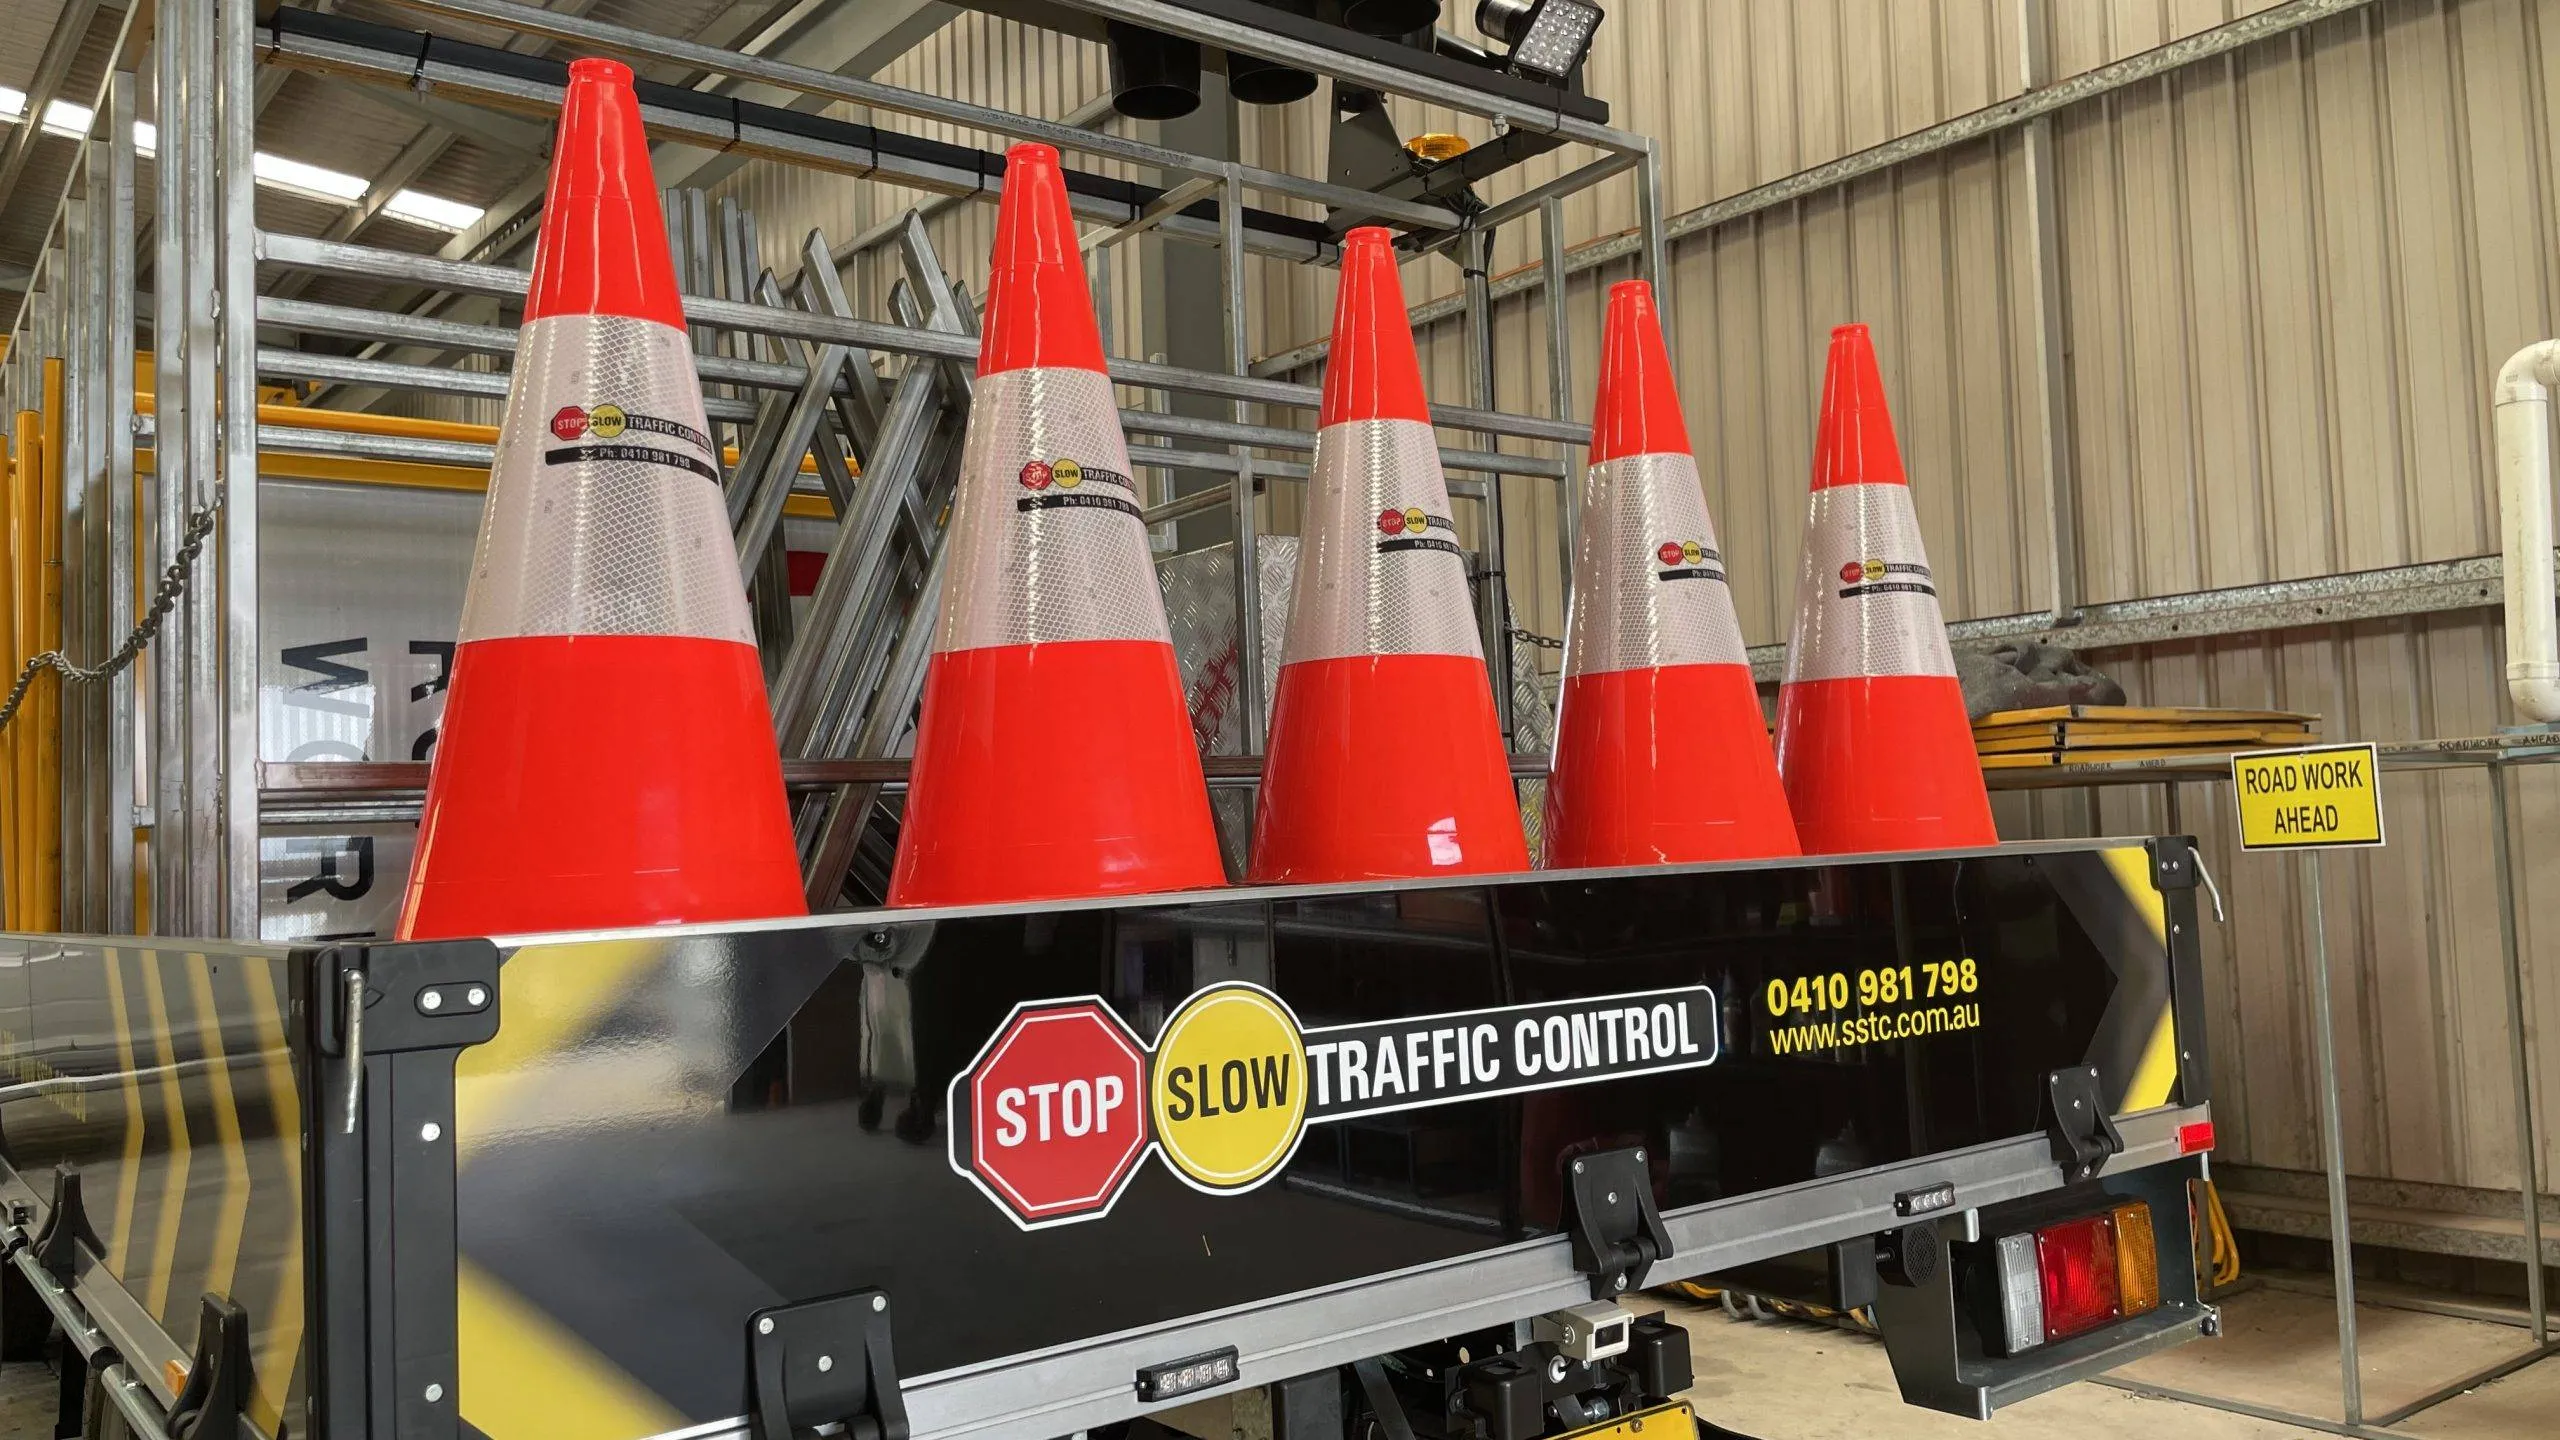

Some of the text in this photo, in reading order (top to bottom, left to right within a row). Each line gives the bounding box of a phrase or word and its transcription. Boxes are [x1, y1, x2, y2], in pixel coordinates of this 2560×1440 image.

[557, 418, 585, 430] STOP
[628, 416, 675, 435] TRAFFIC
[621, 448, 649, 460] 0410
[651, 451, 671, 464] 981
[674, 454, 691, 468] 798
[1054, 469, 1079, 479] SLOW
[1406, 516, 1425, 525] SLOW
[2244, 760, 2363, 794] ROAD WORK
[2275, 805, 2339, 834] AHEAD
[1767, 958, 1978, 1016] 0410 981 798
[1769, 1002, 1980, 1055] www.sstc.com.au
[996, 1001, 1699, 1147] STOP SLOW TRAFFIC CONTROL
